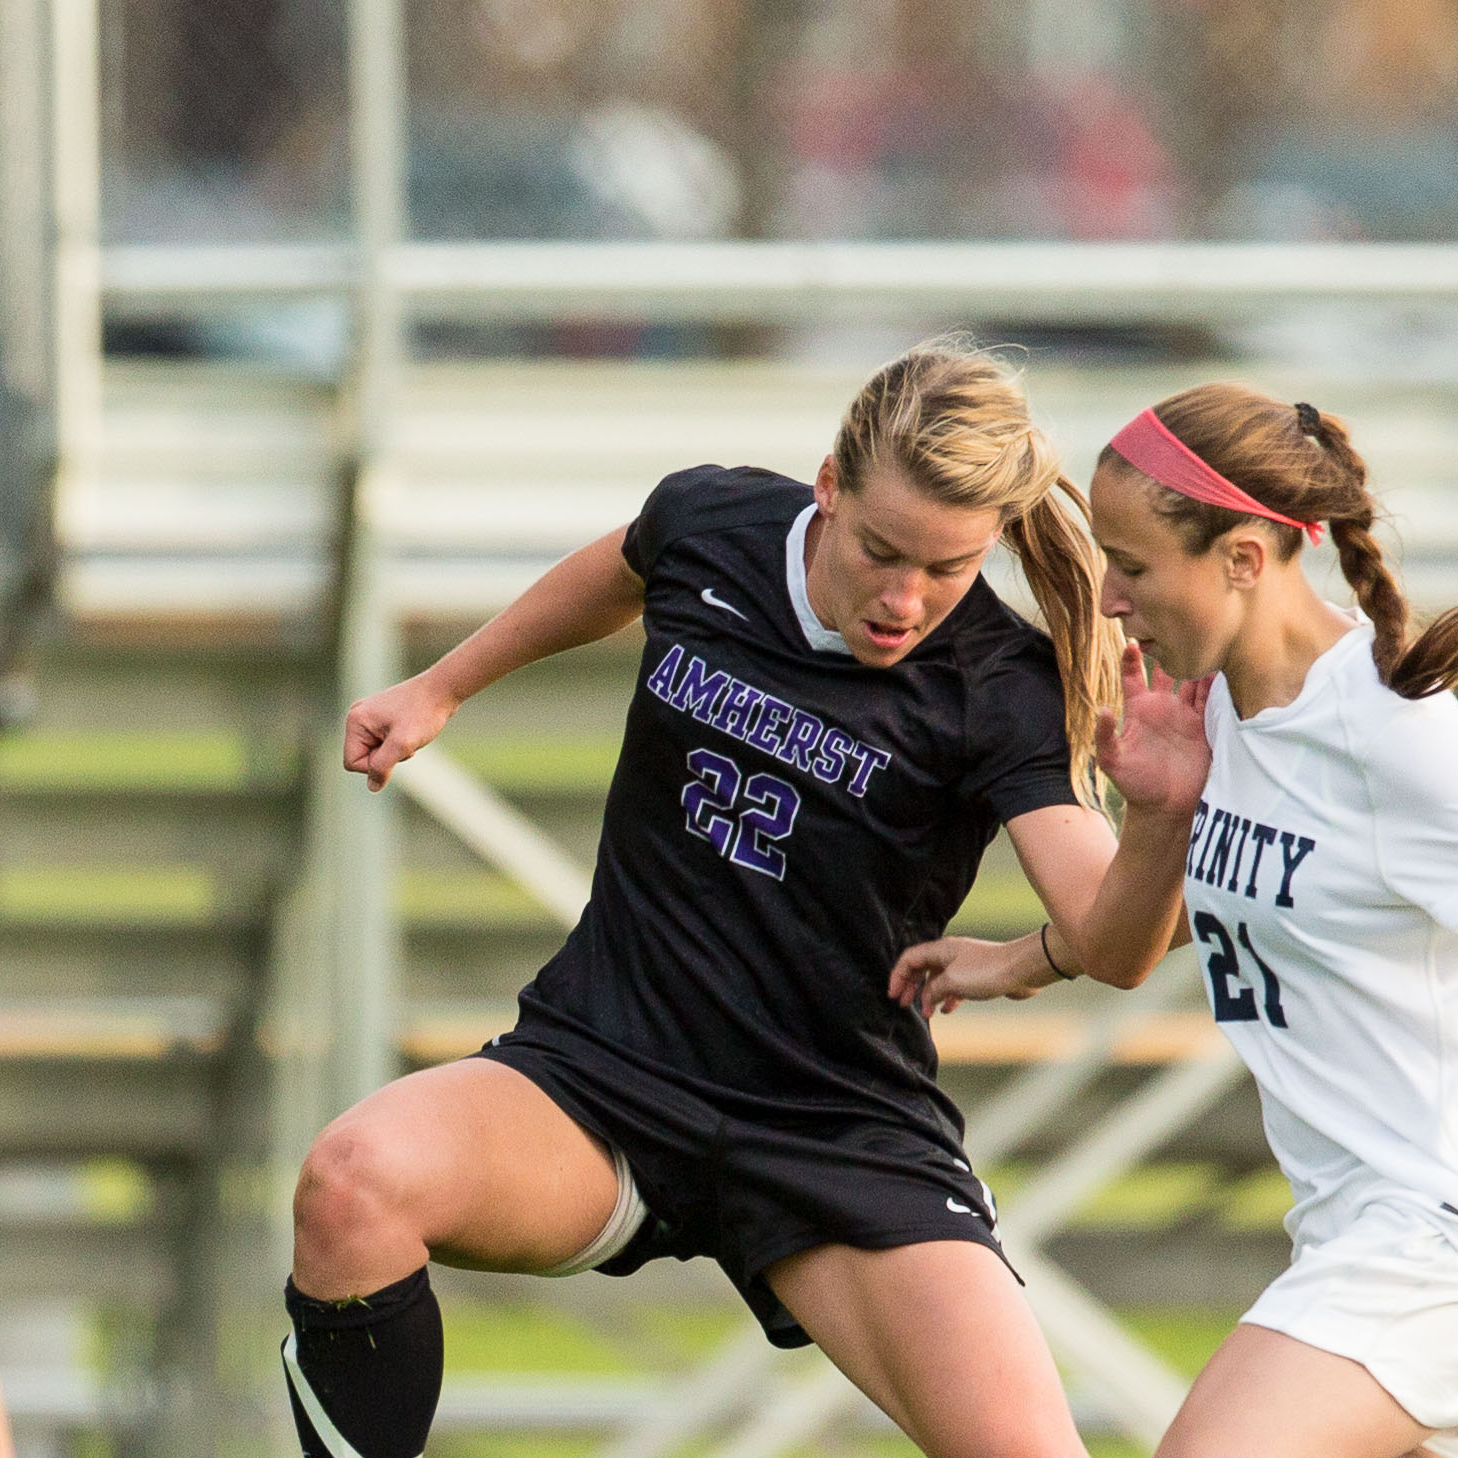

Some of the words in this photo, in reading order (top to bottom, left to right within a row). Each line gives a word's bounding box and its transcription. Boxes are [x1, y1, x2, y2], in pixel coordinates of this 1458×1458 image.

[647, 644, 891, 798] AMHERST
[681, 748, 801, 882] 22
[1187, 799, 1316, 909] RINITY
[1194, 910, 1289, 1029] 21
